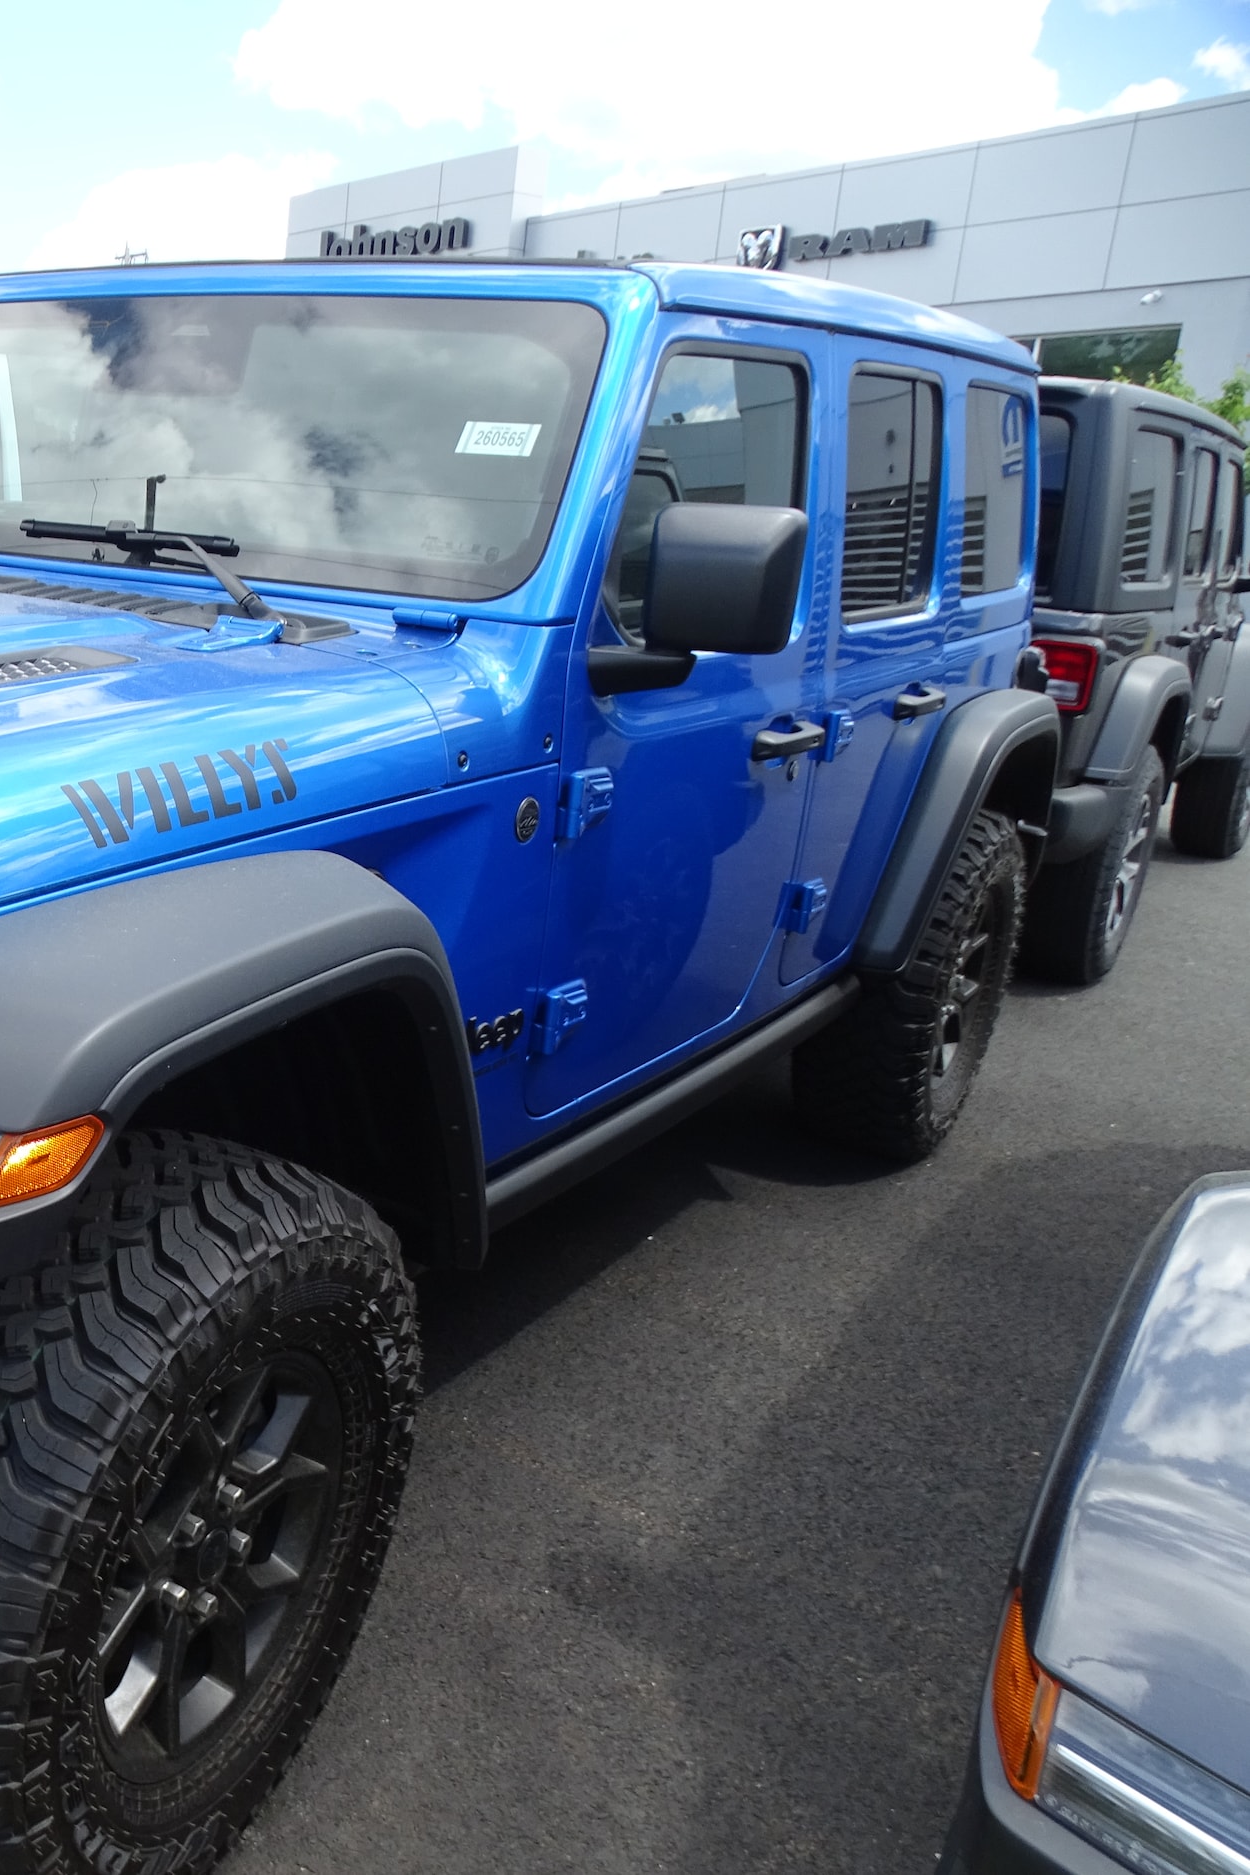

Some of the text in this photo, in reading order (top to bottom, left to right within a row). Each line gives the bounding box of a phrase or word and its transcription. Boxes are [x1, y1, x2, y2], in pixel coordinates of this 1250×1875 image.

[320, 217, 469, 256] Johnson
[790, 219, 931, 261] RAM
[473, 430, 526, 447] 260565
[60, 738, 297, 848] WILLYS
